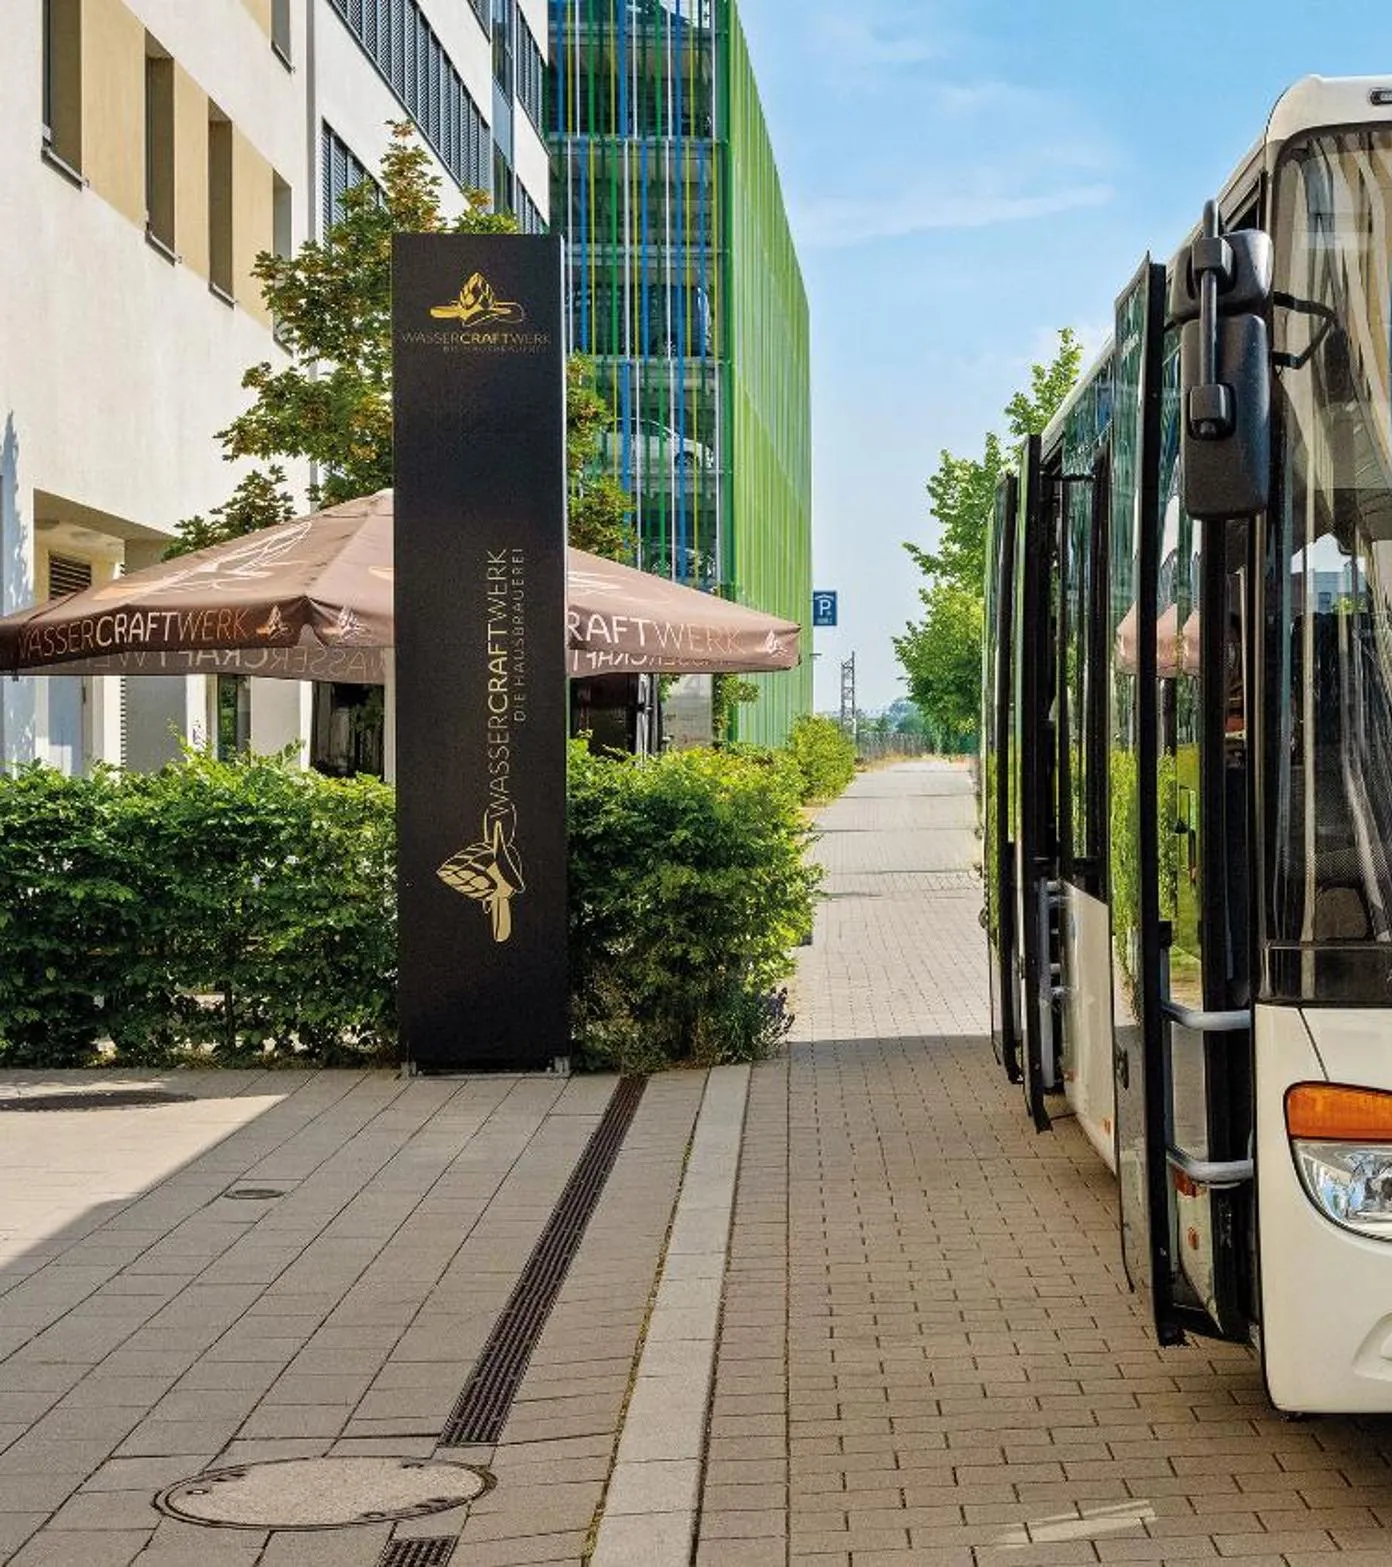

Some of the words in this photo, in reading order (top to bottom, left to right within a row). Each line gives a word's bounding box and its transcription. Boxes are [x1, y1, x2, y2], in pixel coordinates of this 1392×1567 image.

[402, 331, 550, 345] WASSERCRAFTWERK
[512, 549, 525, 686] HAUSBRAUEREI
[819, 599, 831, 616] P
[487, 549, 509, 818] WASSERCRAFTWERK
[513, 693, 526, 721] DIE
